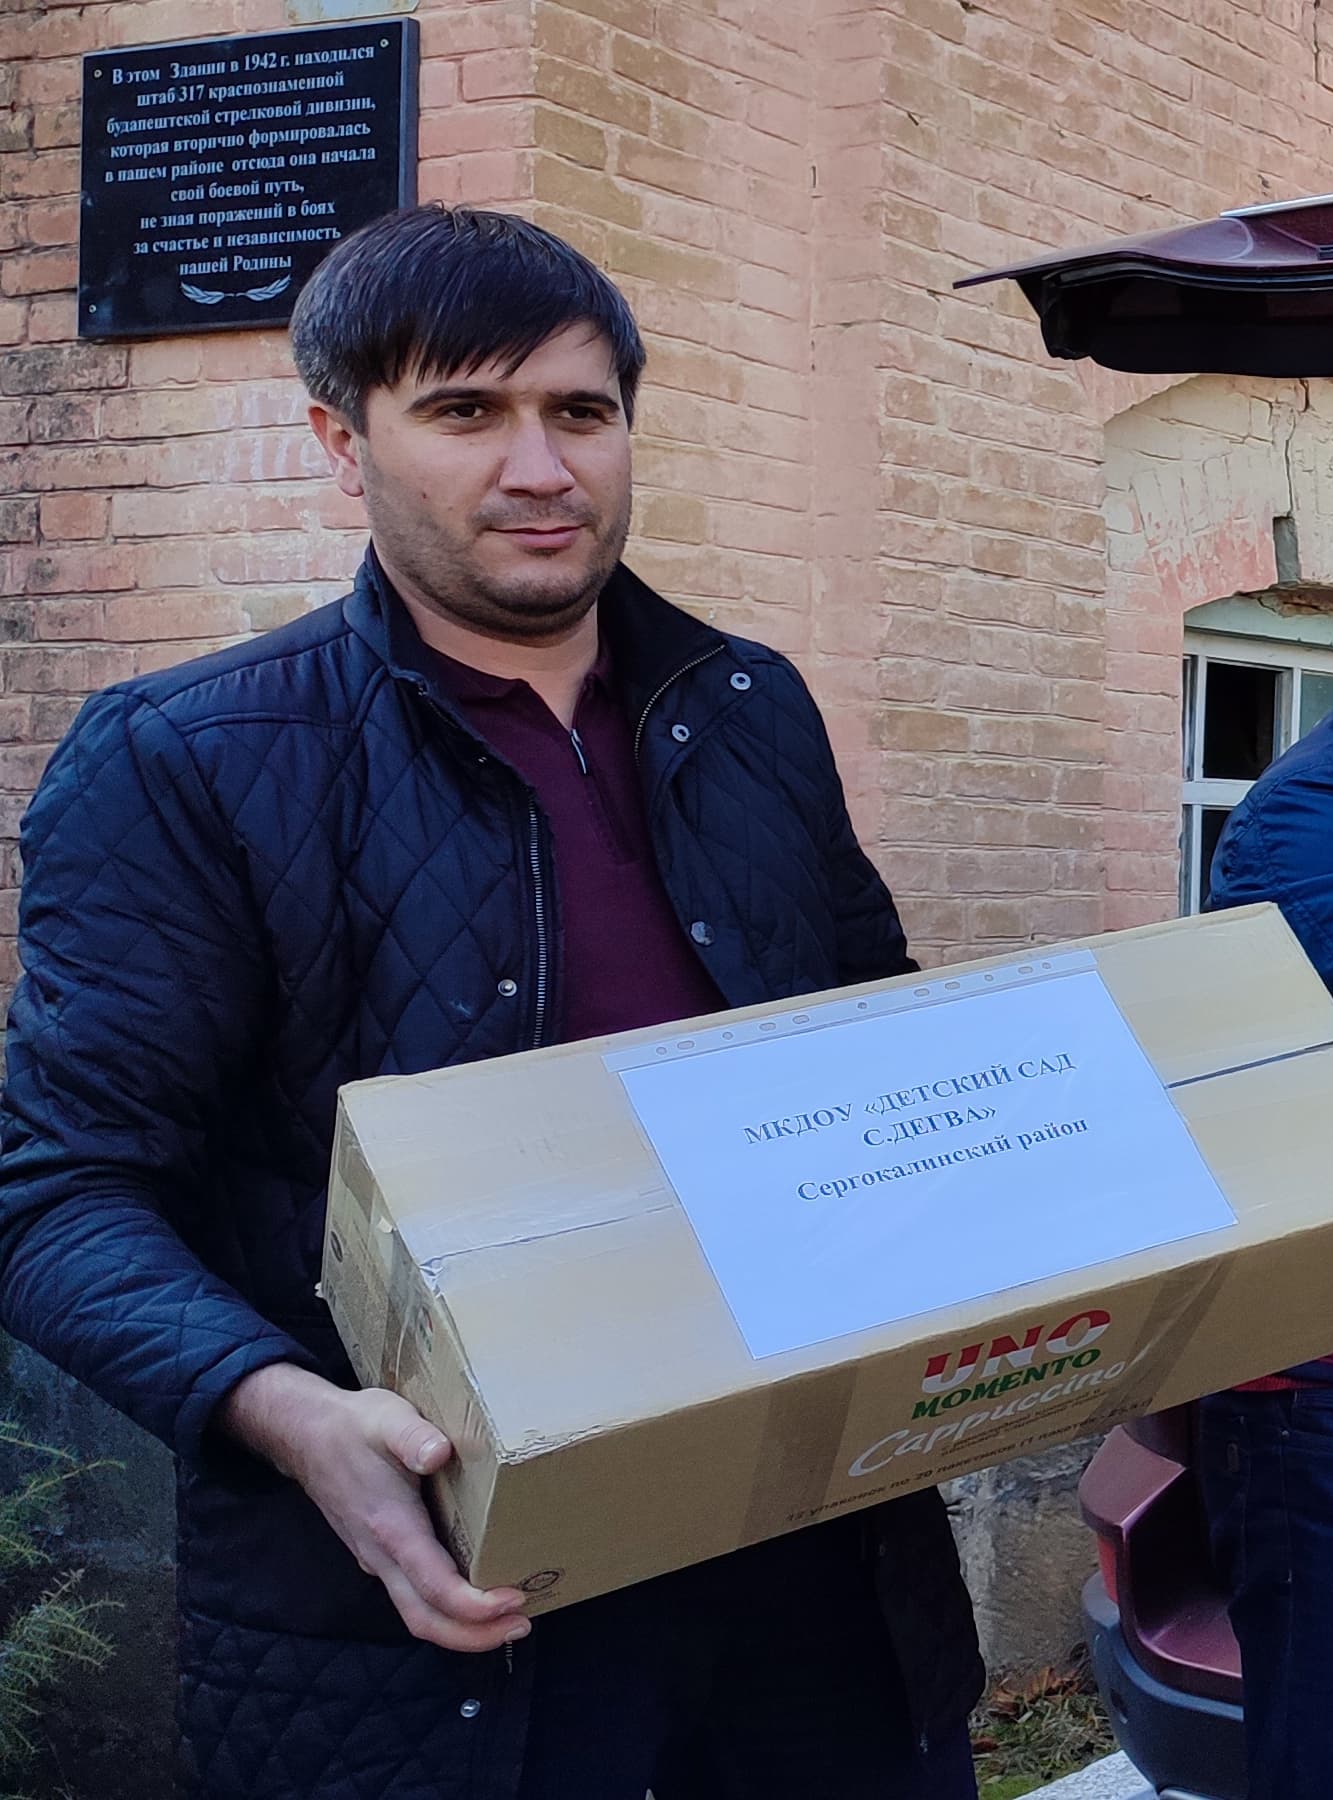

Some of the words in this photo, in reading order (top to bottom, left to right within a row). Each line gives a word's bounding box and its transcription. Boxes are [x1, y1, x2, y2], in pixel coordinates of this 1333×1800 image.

[112, 68, 123, 85] В
[126, 70, 161, 84] этом
[169, 61, 226, 80] Здании
[230, 60, 240, 73] в
[244, 52, 277, 71] 1942
[279, 55, 291, 68] г.
[294, 45, 375, 67] находился
[136, 86, 176, 107] штаб
[178, 84, 205, 102] 317
[207, 71, 345, 103] краснознаменной
[106, 109, 210, 138] будапештской
[213, 100, 301, 127] стрелковой
[304, 96, 376, 116] дивизии,
[110, 139, 170, 159] которая
[173, 133, 245, 153] вторично
[248, 121, 372, 149] формировалась
[104, 170, 114, 183] в
[117, 166, 168, 182] нашем
[170, 159, 225, 181] районе
[231, 154, 286, 172] отсюда
[289, 151, 317, 168] она
[320, 146, 377, 164] начала
[170, 184, 206, 202] свой
[208, 180, 260, 199] боевой
[263, 178, 305, 197] путь,
[140, 214, 158, 230] не
[159, 212, 194, 229] зная
[198, 203, 284, 228] поражений
[287, 203, 297, 218] в
[300, 199, 336, 216] боях
[132, 241, 149, 256] за
[152, 234, 210, 254] счастье
[212, 234, 223, 249] и
[226, 226, 342, 248] независимость
[179, 255, 229, 276] нашей
[232, 253, 292, 274] Родины
[743, 1103, 854, 1145] МКДОУ
[863, 1063, 1014, 1116] «ДЕТСКИЙ
[1018, 1052, 1078, 1081] САД
[862, 1105, 997, 1148] С.ДЕГВА»
[797, 1135, 1014, 1202] Сергокалинский
[1016, 1118, 1090, 1153] район
[920, 1308, 1112, 1394] UNO
[911, 1348, 1102, 1420] MOMENTO
[847, 1360, 1126, 1478] Cappuccino
